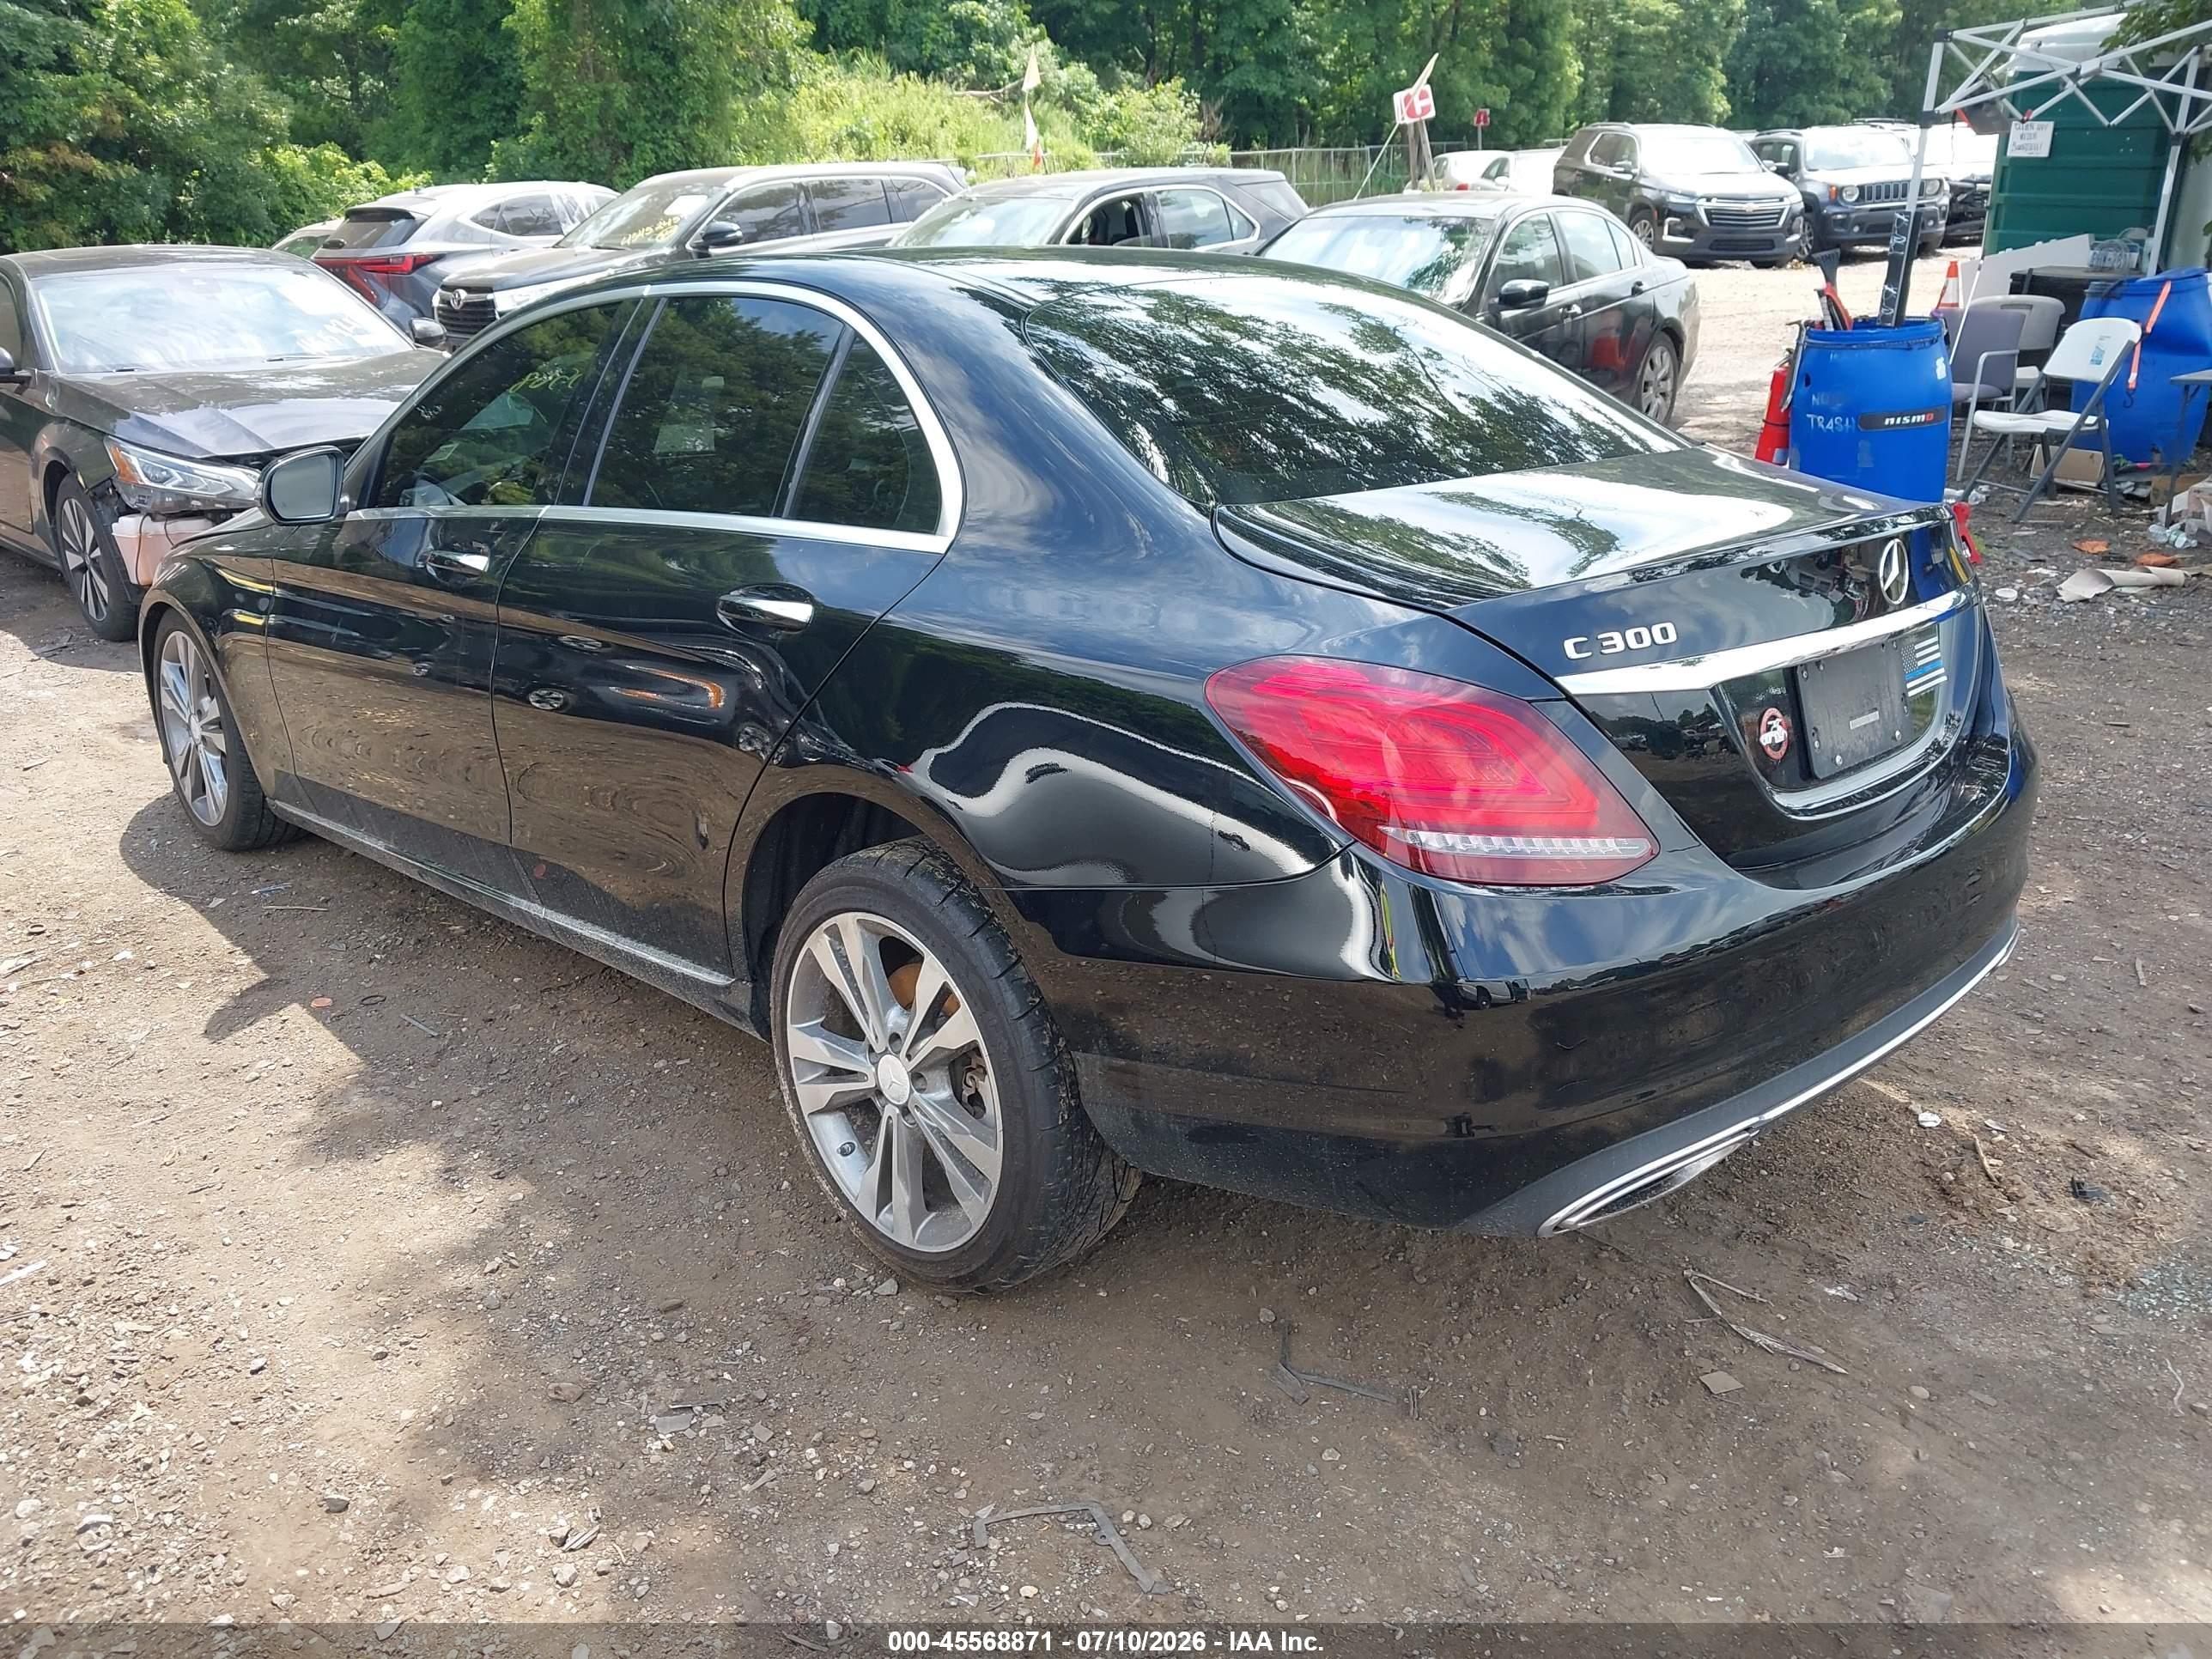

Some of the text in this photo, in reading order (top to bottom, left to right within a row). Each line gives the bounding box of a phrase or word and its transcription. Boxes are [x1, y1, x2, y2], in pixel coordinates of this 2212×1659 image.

[1806, 413, 1856, 433] TRASH
[1563, 622, 1678, 660] C 300
